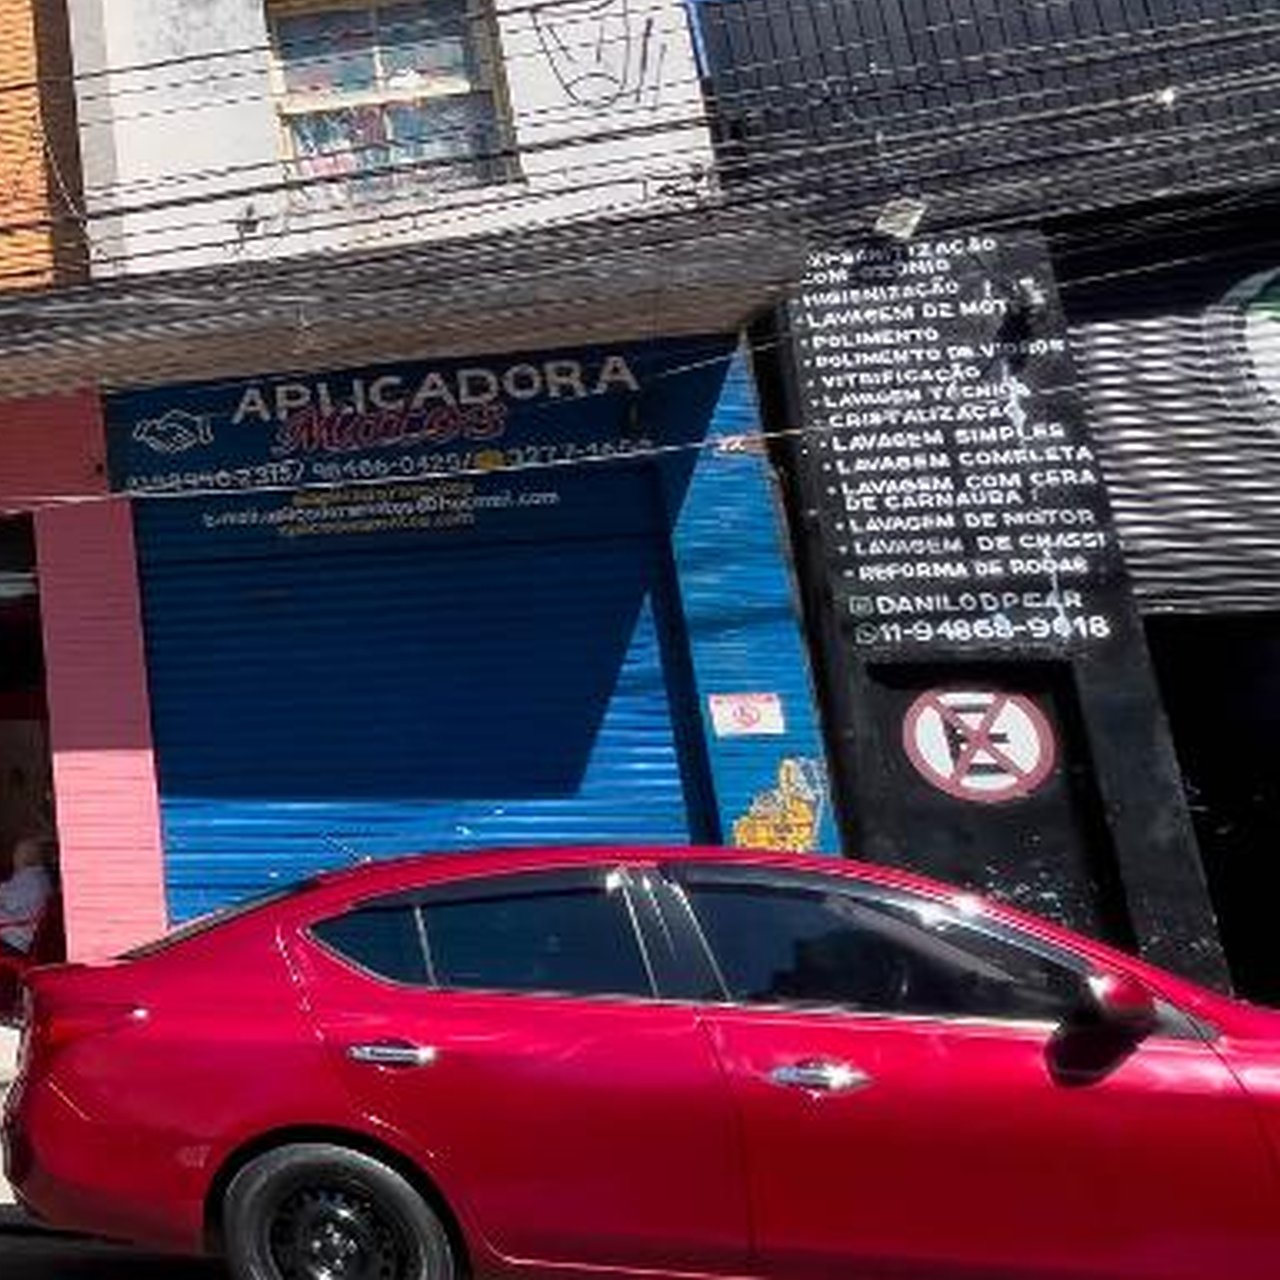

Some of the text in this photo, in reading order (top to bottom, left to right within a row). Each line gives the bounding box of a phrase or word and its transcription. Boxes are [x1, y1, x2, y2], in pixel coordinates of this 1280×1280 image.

[806, 305, 915, 328] LAVAGEM
[922, 303, 956, 319] DE
[812, 326, 939, 349] POLIMENTO
[815, 344, 941, 368] POLIMENTO
[232, 356, 640, 424] APLICADORA
[823, 387, 922, 409] LAVAGEM
[832, 422, 1066, 452] LAVAGEM SIMPLES
[836, 446, 1094, 475] LAVAGEM COMPLETA
[841, 468, 1098, 496] LAVAGEM COM CERA
[845, 495, 878, 511] DE
[849, 508, 1095, 533] LAVAGEM DE MOTOR
[854, 532, 1106, 556] LAVAGEM DE CHASSI
[859, 556, 1089, 581] REFORMA DE RODAS
